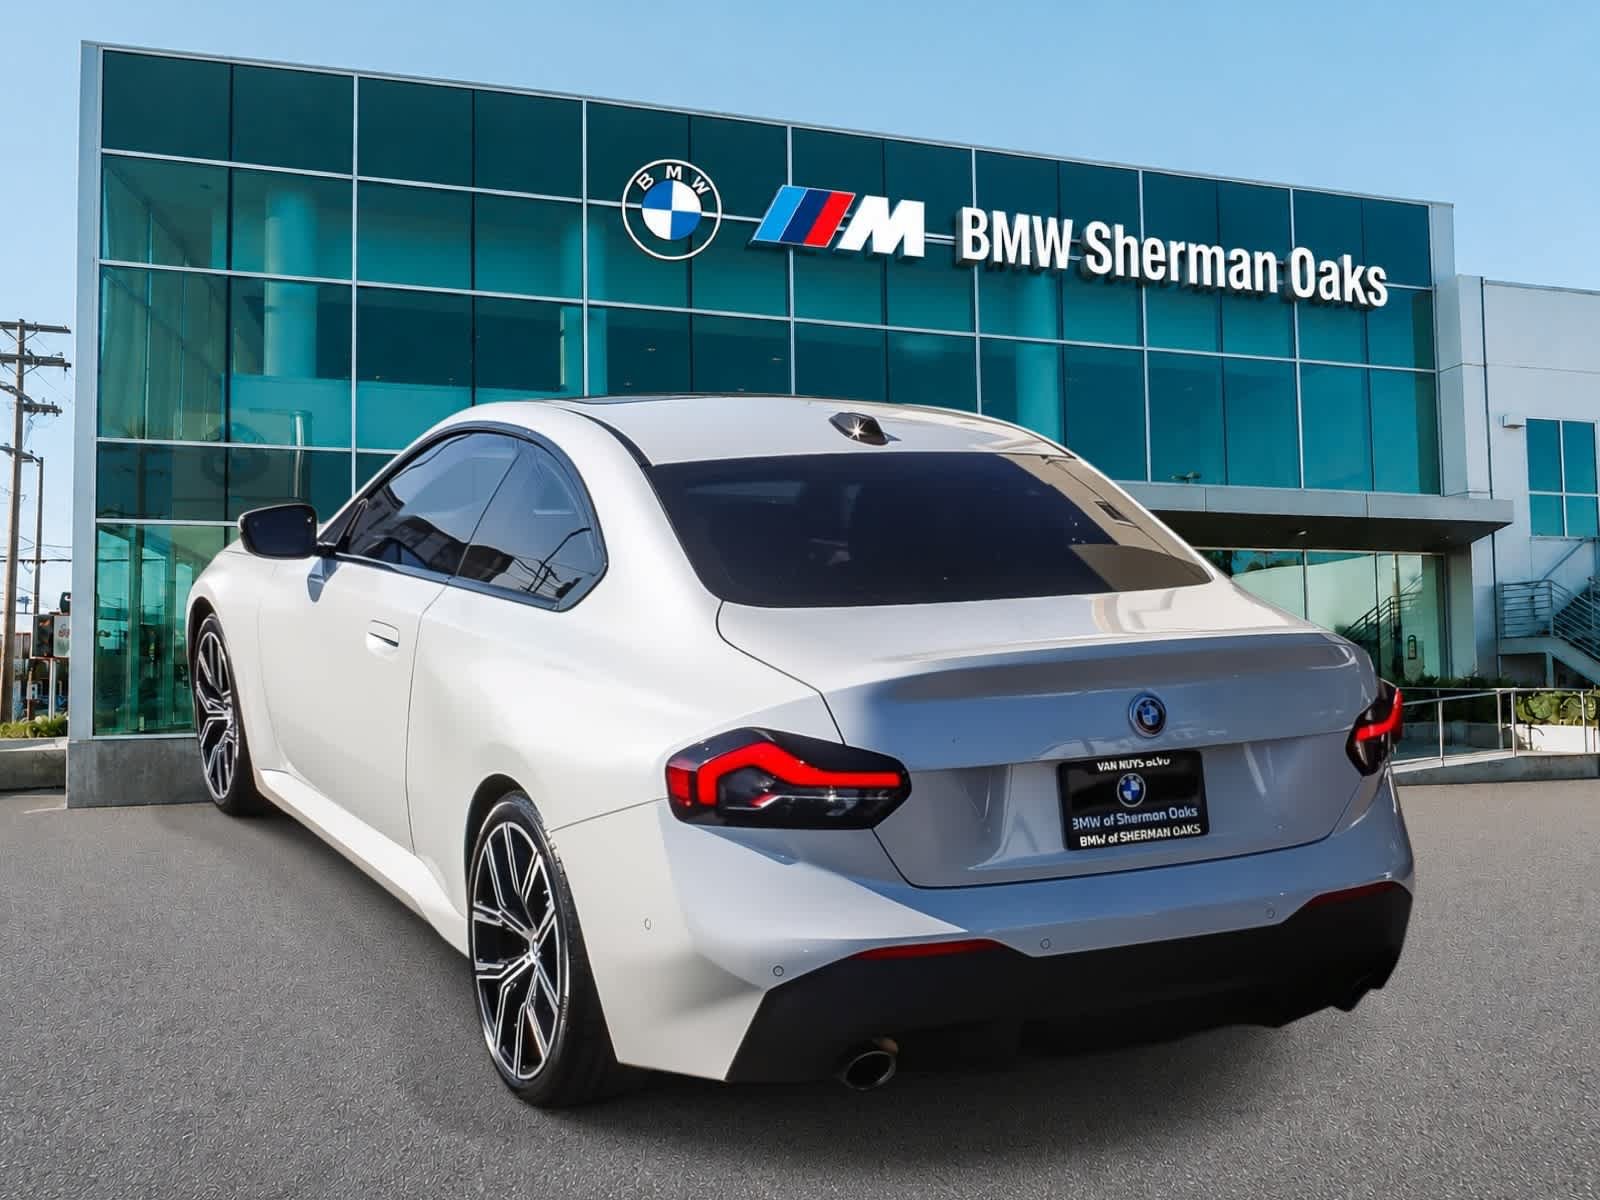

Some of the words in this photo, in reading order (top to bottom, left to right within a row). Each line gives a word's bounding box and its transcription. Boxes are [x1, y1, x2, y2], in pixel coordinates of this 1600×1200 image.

[636, 165, 711, 195] BMW
[961, 206, 1073, 269] BMW
[1085, 221, 1278, 293] Sherman
[1290, 247, 1388, 307] Oaks
[1097, 760, 1118, 772] VAN
[1119, 759, 1145, 770] NUYS
[1103, 814, 1115, 827] of
[1116, 811, 1167, 826] Sherman
[1168, 806, 1198, 819] Oaks
[1079, 834, 1106, 847] BMW
[1108, 832, 1119, 844] of
[1119, 827, 1171, 843] SHERMAN
[1172, 823, 1201, 836] OAKS
